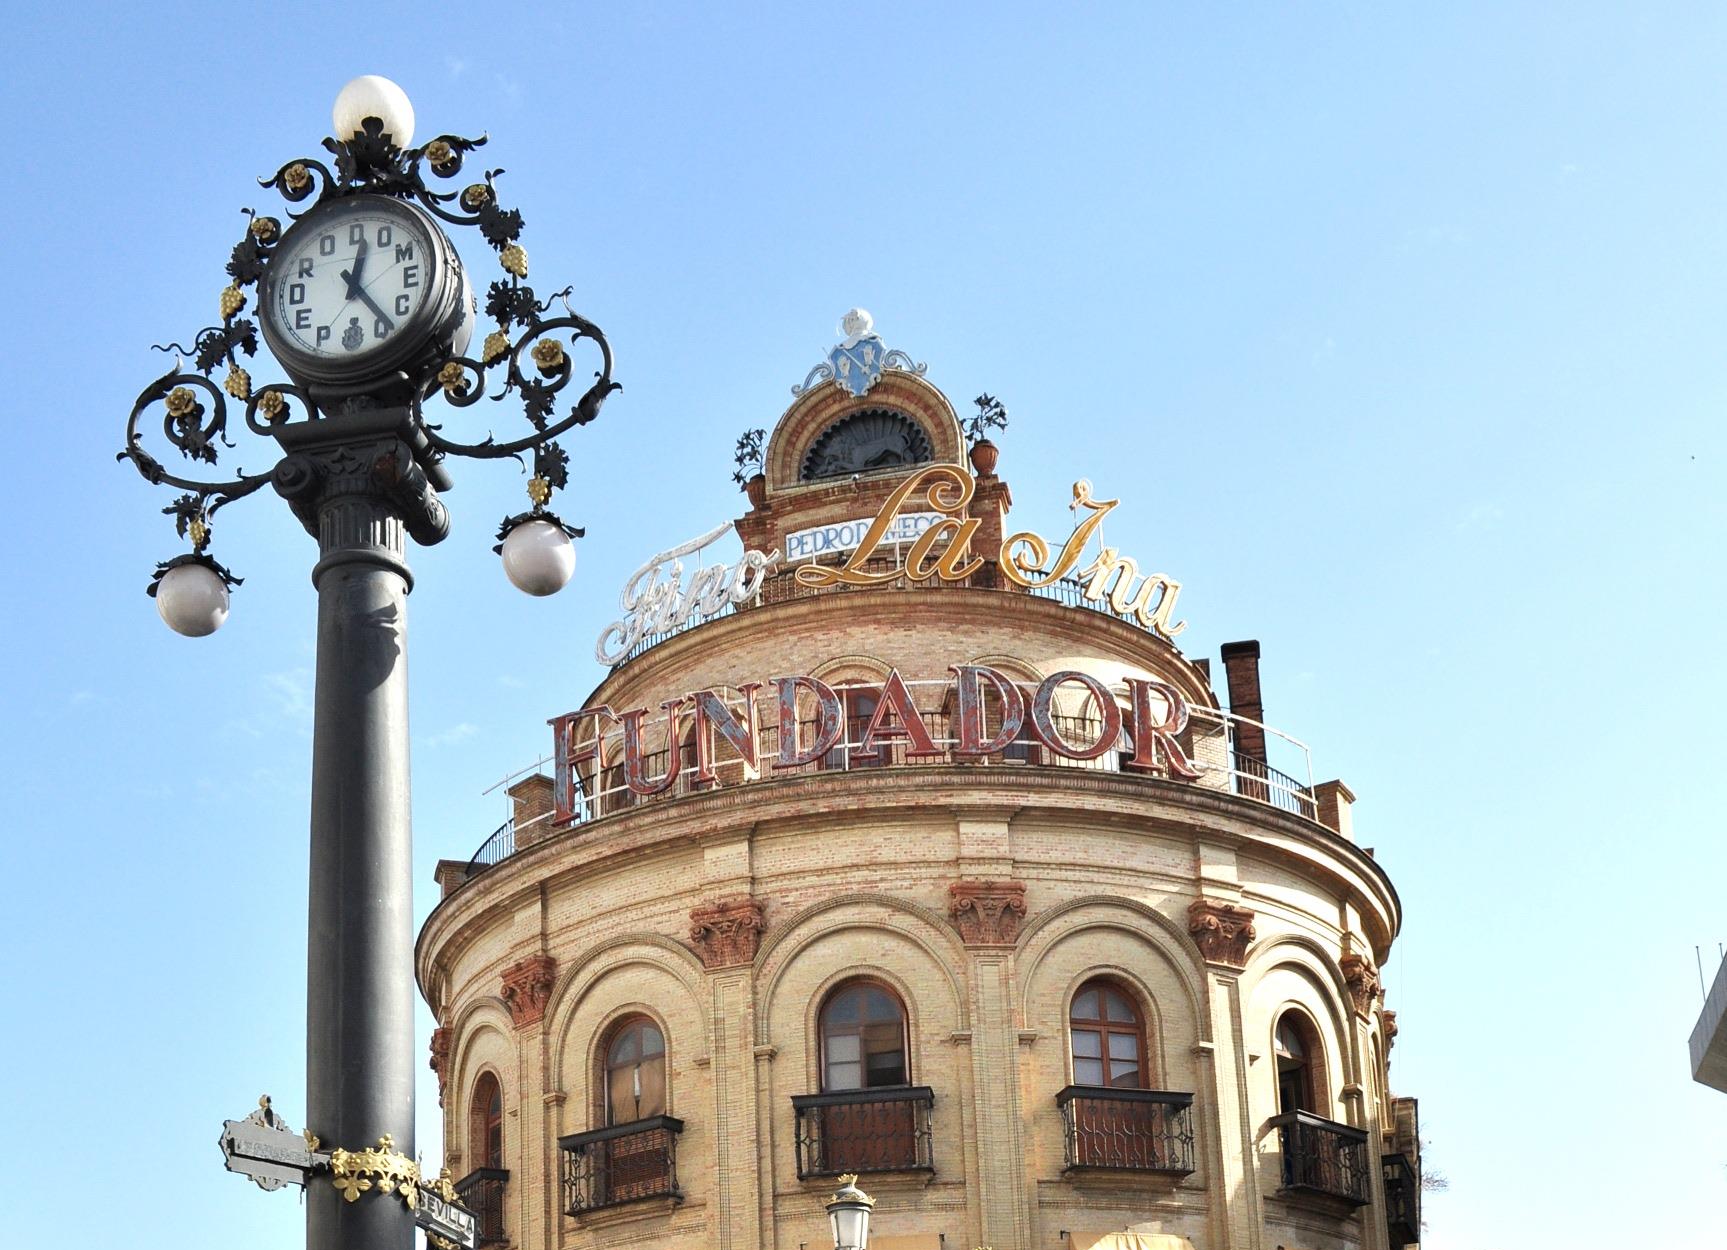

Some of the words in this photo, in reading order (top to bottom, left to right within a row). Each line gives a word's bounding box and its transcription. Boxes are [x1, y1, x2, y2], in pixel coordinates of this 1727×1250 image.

[596, 521, 780, 667] Fino
[795, 464, 985, 589] La
[1000, 478, 1188, 637] Ina
[787, 525, 855, 559] PEDRO
[547, 664, 1206, 827] FUNDADOR
